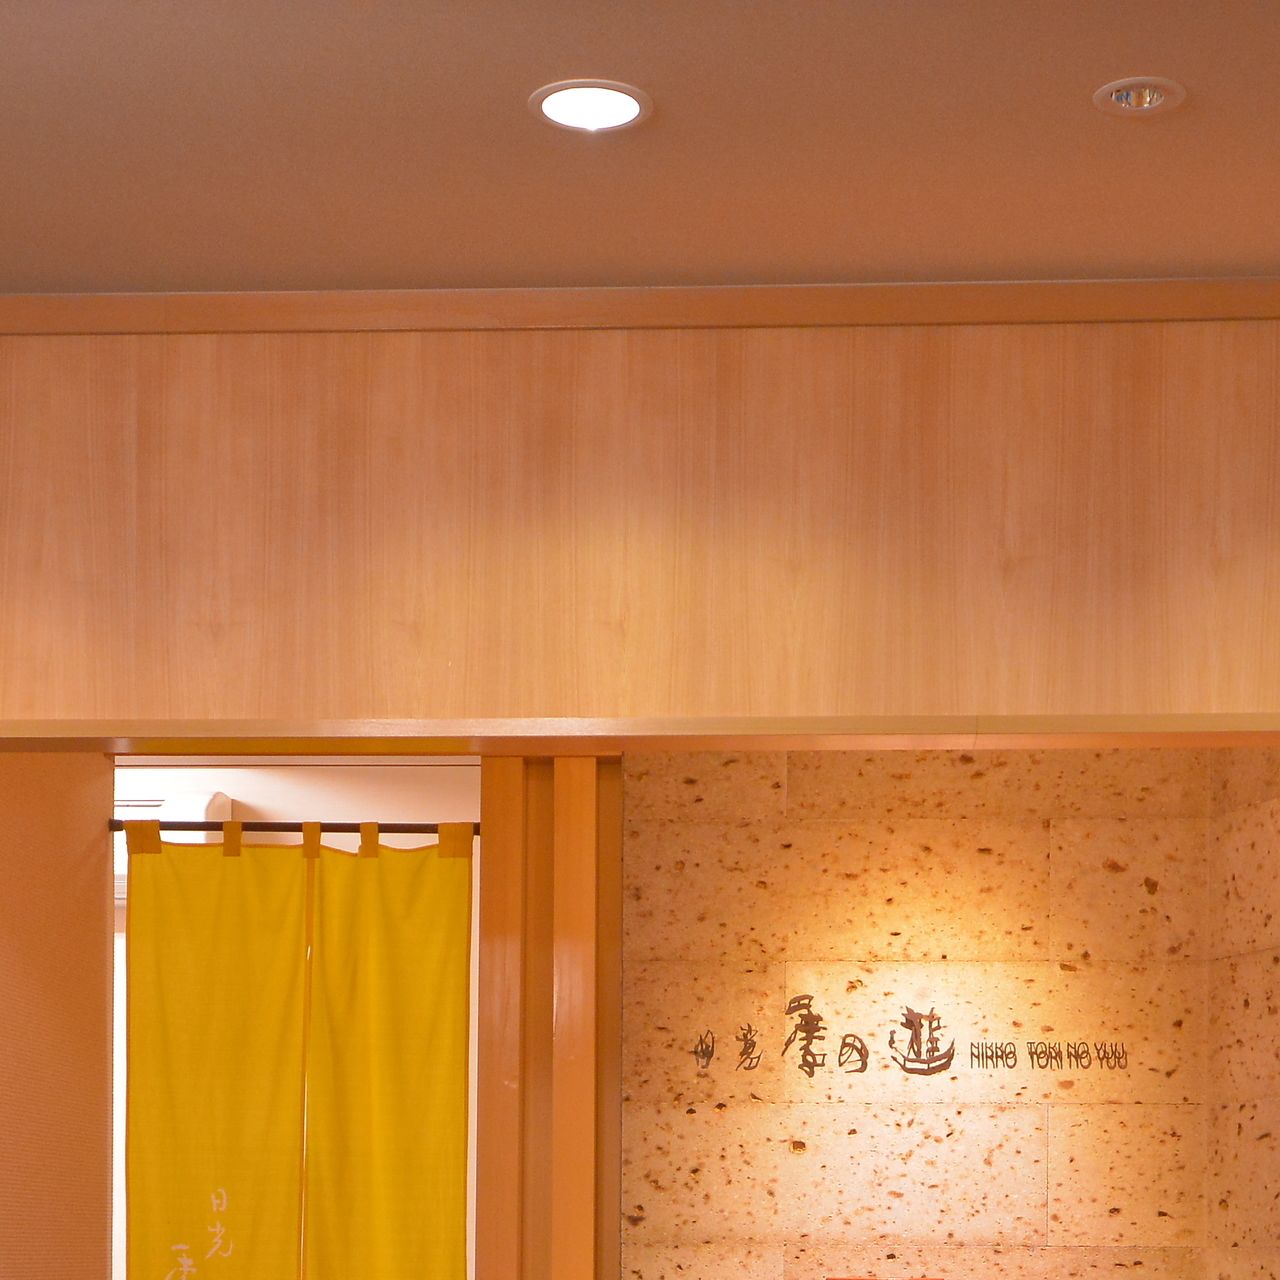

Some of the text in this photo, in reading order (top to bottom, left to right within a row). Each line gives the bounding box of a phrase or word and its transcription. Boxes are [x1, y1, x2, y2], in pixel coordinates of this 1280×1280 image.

[970, 1041, 1128, 1070] NIKKO TOKI NO YUU
[205, 1187, 235, 1260] 日光
